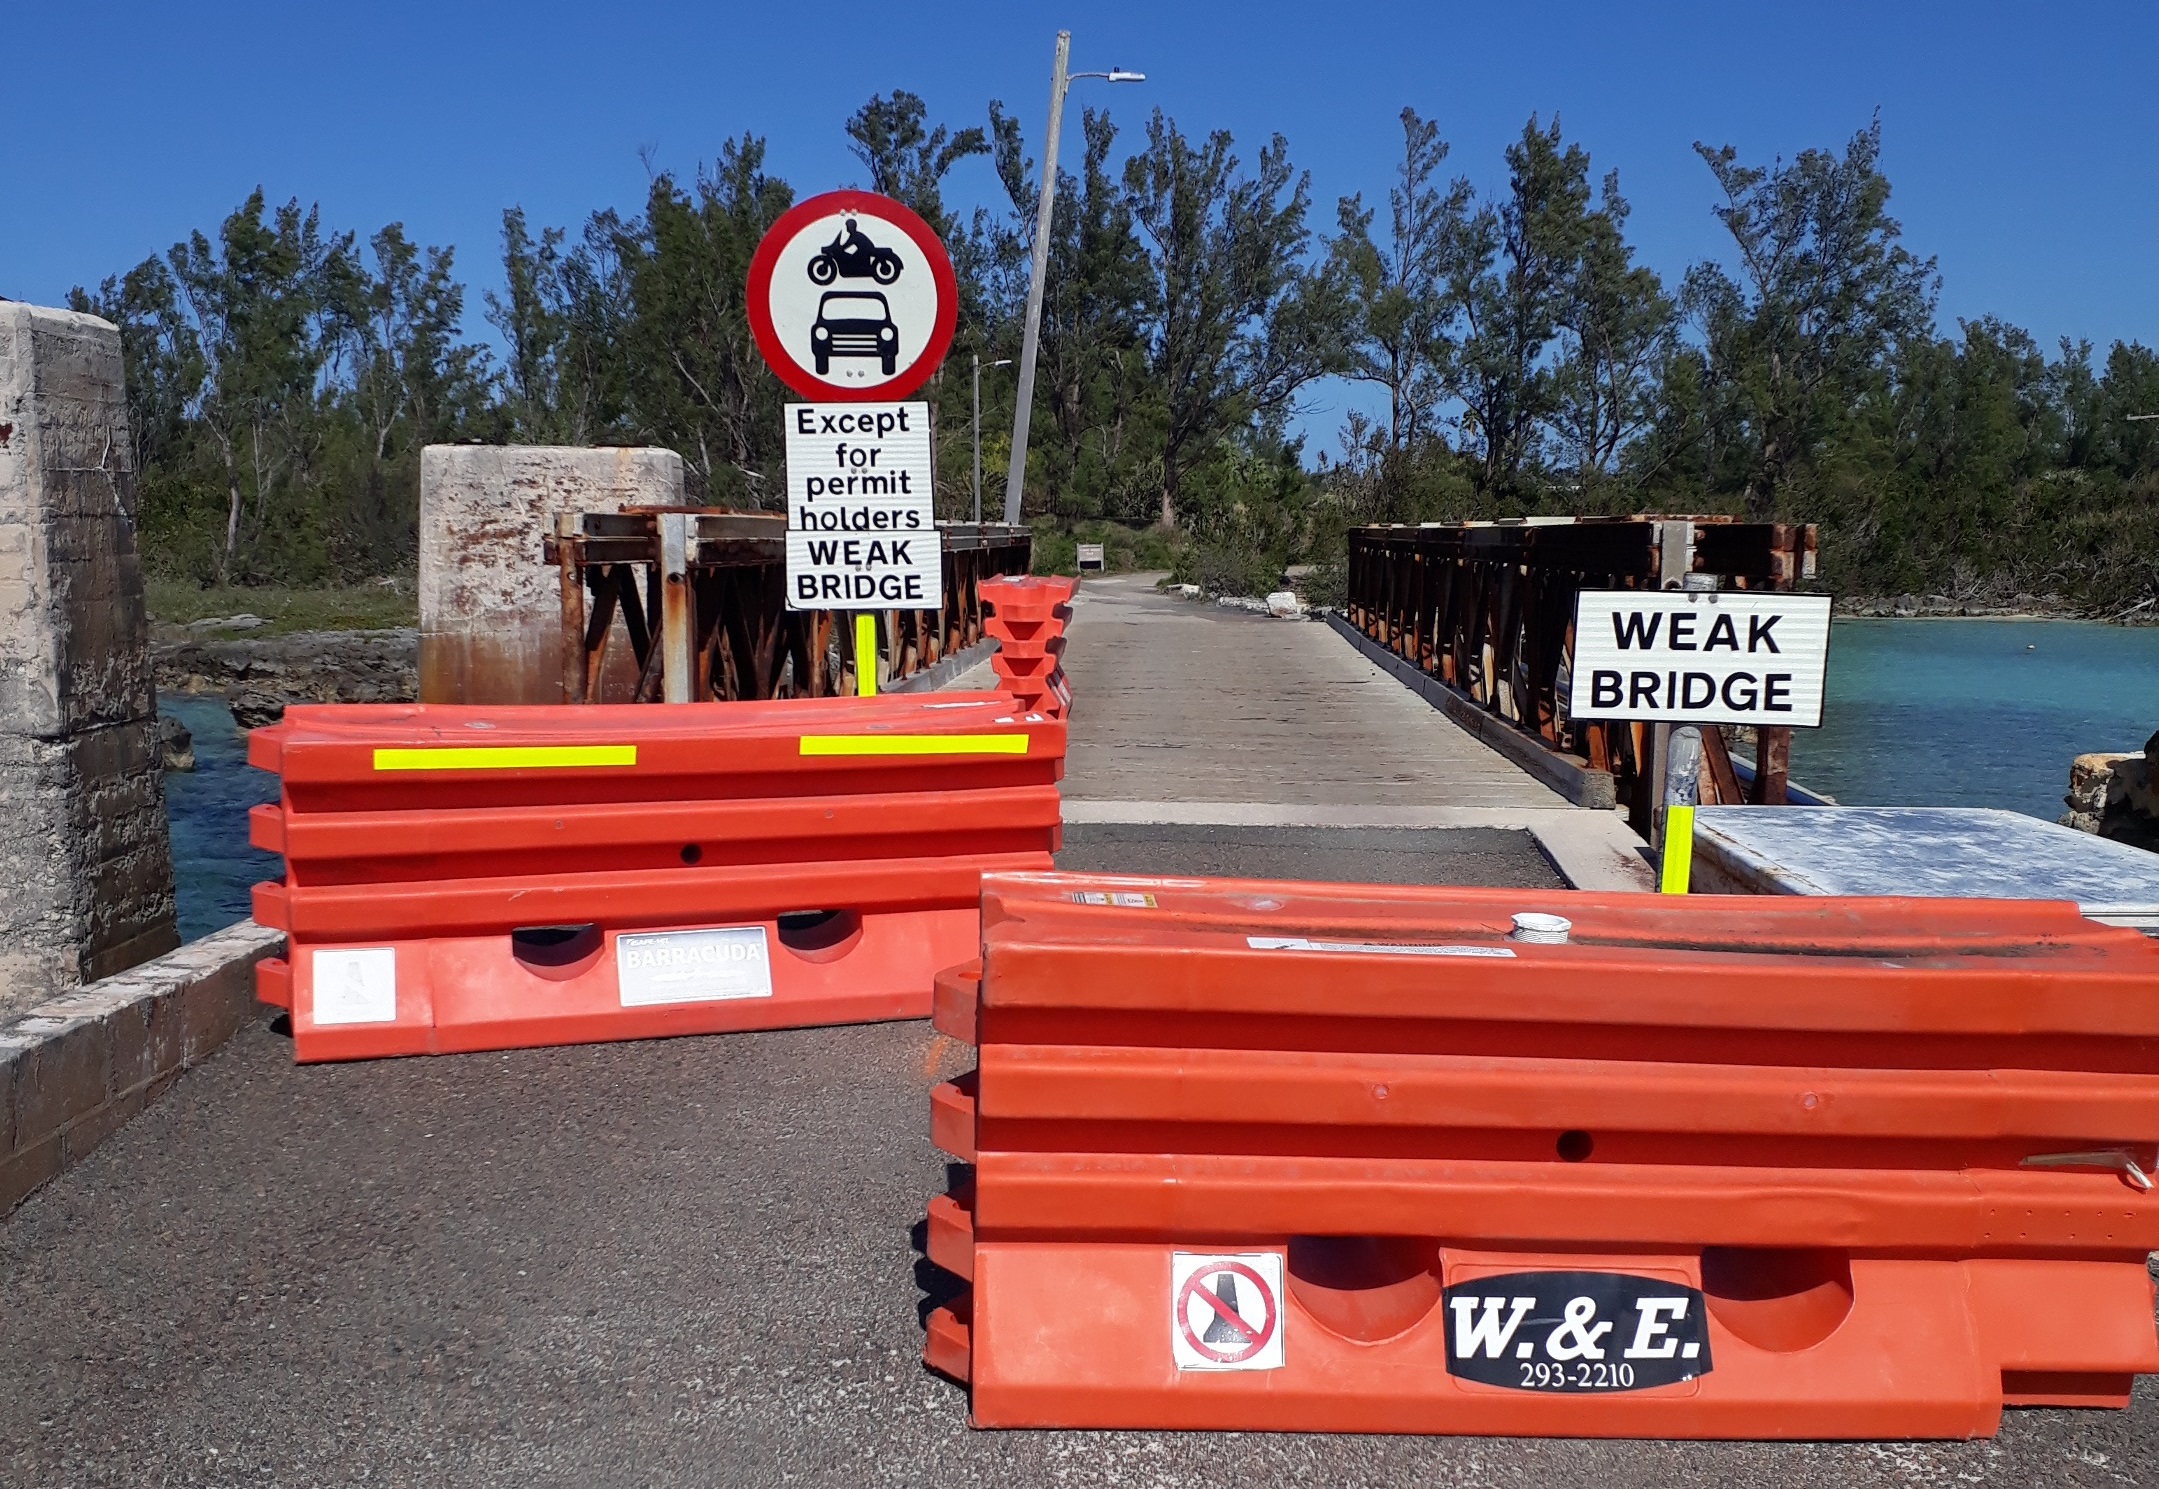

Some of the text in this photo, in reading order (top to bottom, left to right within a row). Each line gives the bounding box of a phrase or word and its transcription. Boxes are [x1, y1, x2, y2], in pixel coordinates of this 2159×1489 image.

[797, 406, 910, 438] Except
[836, 443, 881, 467] for
[807, 470, 911, 502] permit
[800, 506, 920, 530] holders
[807, 540, 913, 565] WEAK
[797, 574, 923, 600] BRIDGE
[1612, 612, 1783, 653] WEAK
[1591, 670, 1792, 711] BRIDGE
[626, 943, 762, 969] BARRACUDA
[1450, 1296, 1701, 1361] W. & E.
[1520, 1362, 1635, 1388] 293-2210
